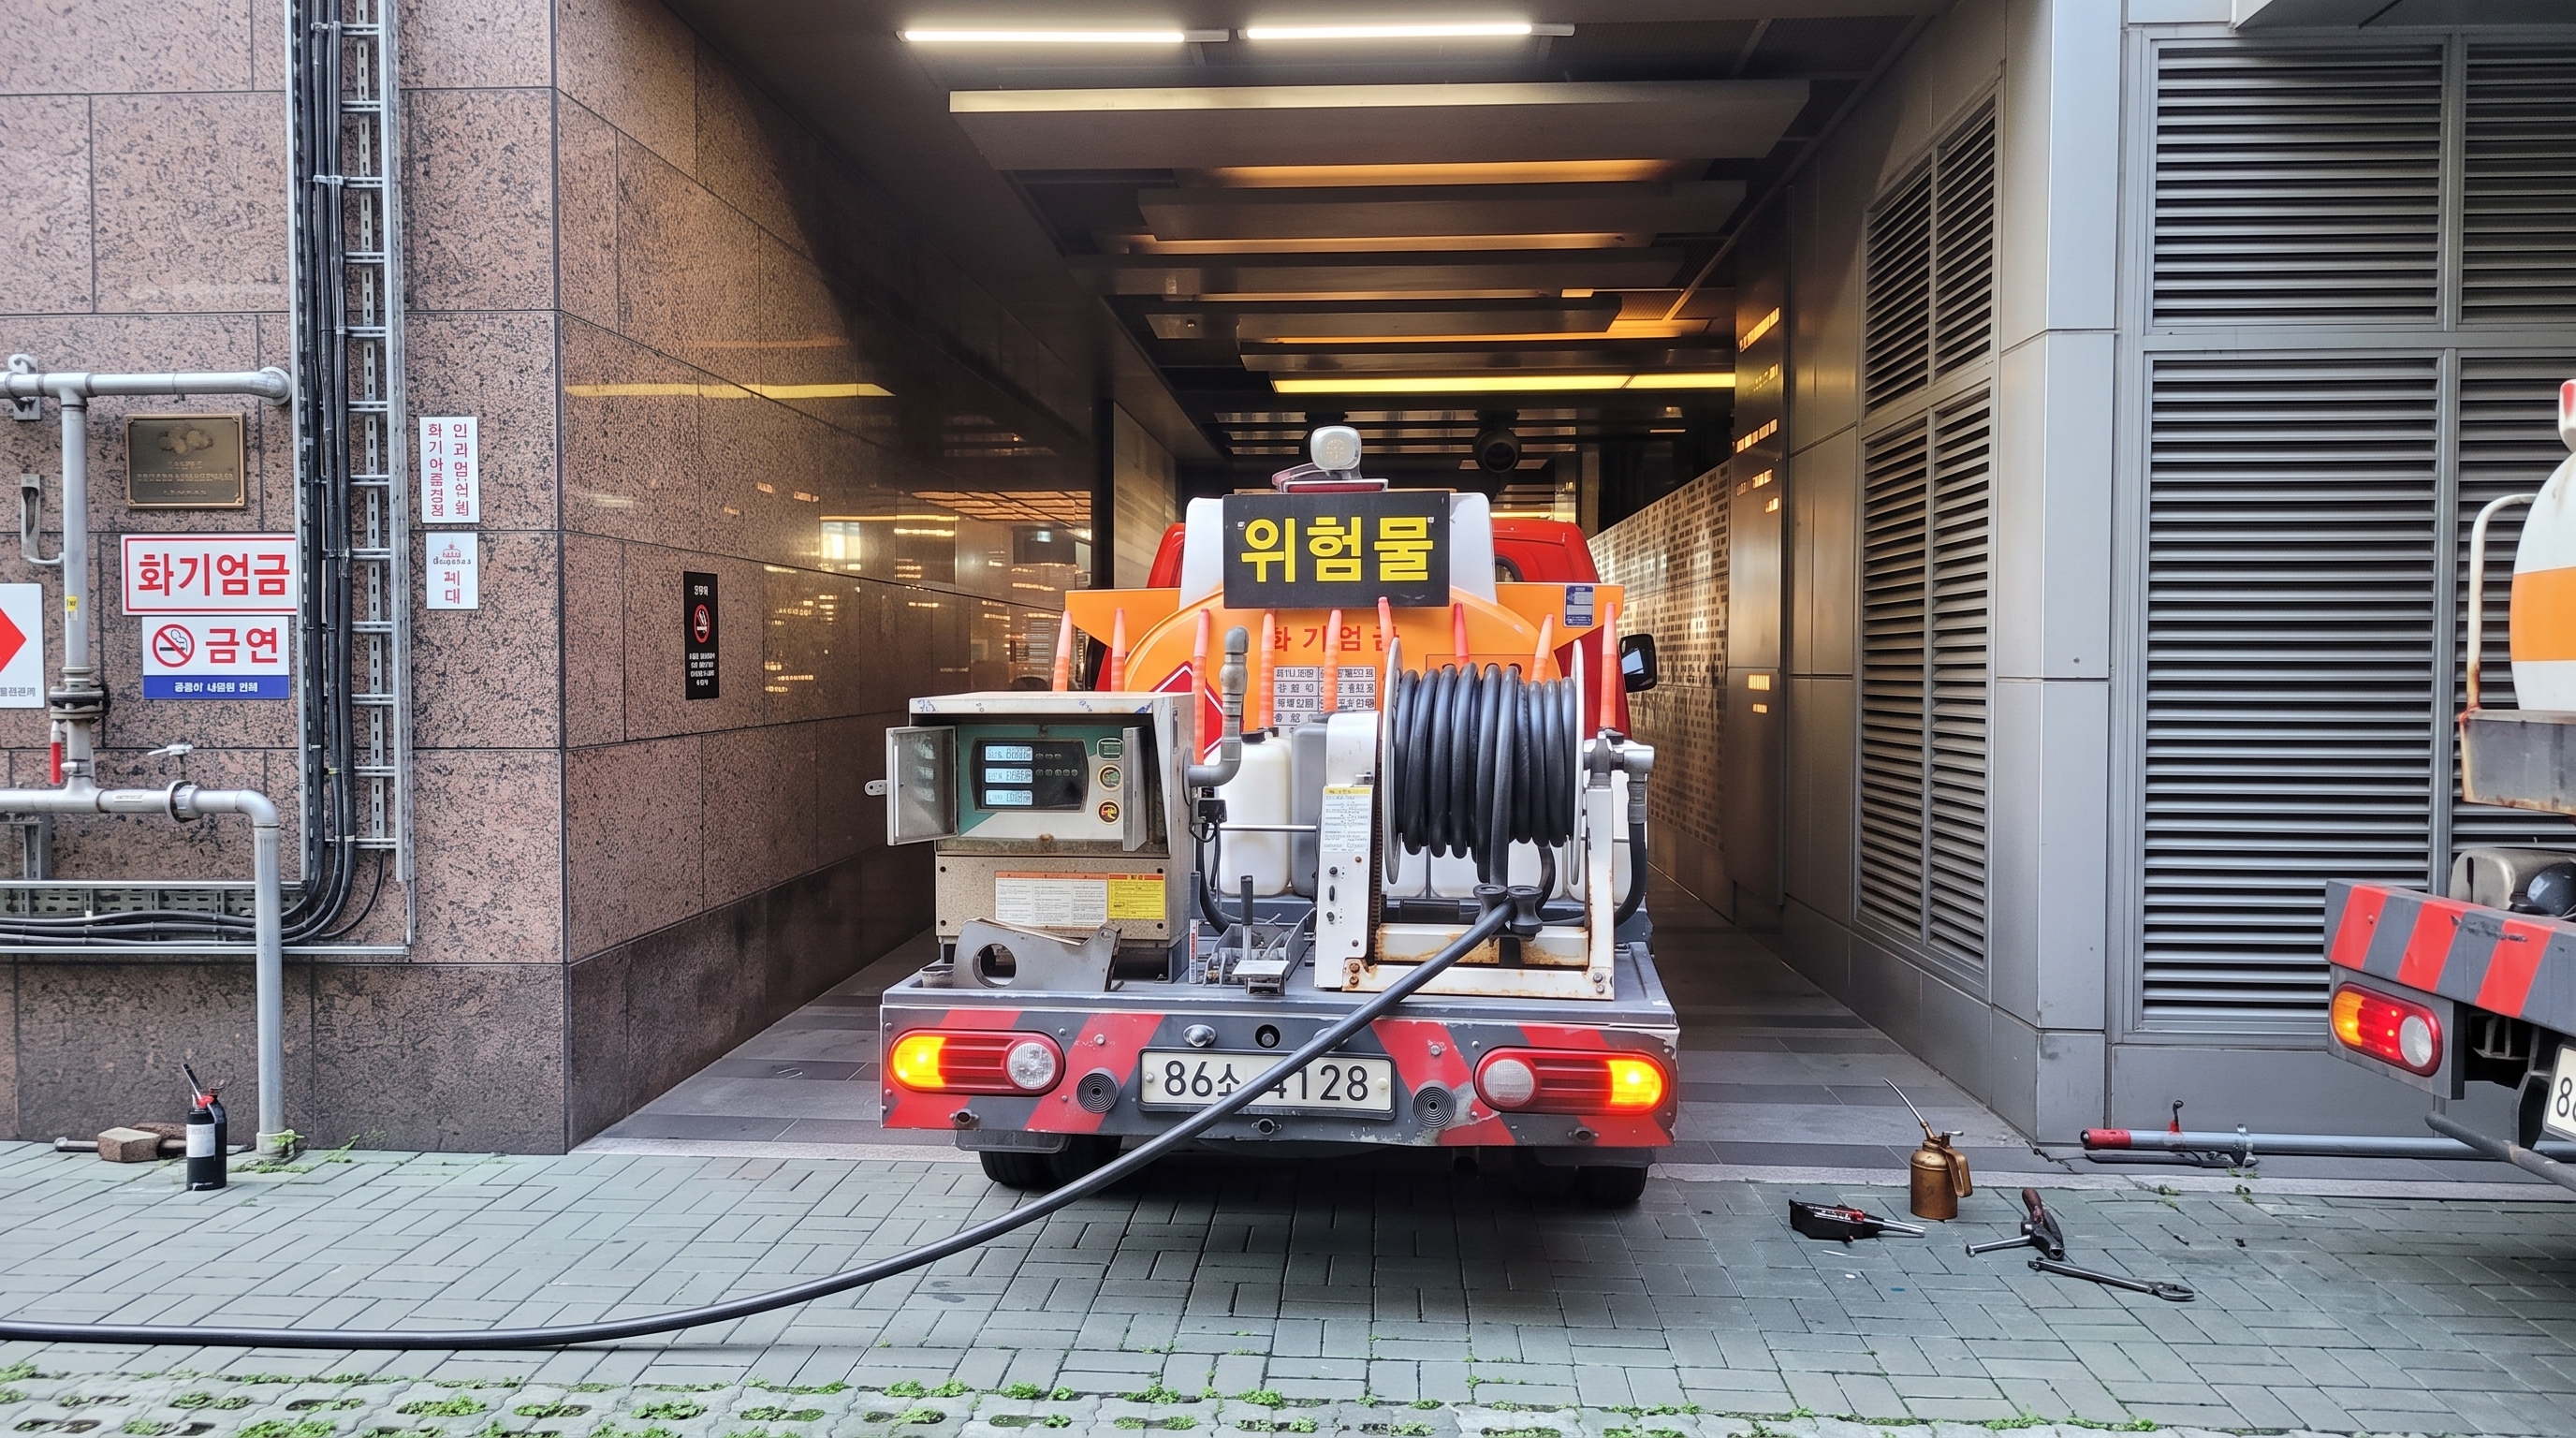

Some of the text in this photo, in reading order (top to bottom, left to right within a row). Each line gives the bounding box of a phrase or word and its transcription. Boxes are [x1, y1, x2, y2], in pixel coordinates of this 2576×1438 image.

[1241, 516, 1434, 582] 위험물
[138, 552, 290, 596] 화기엄금
[205, 627, 278, 664] 금연
[2556, 1077, 2576, 1122] 8
